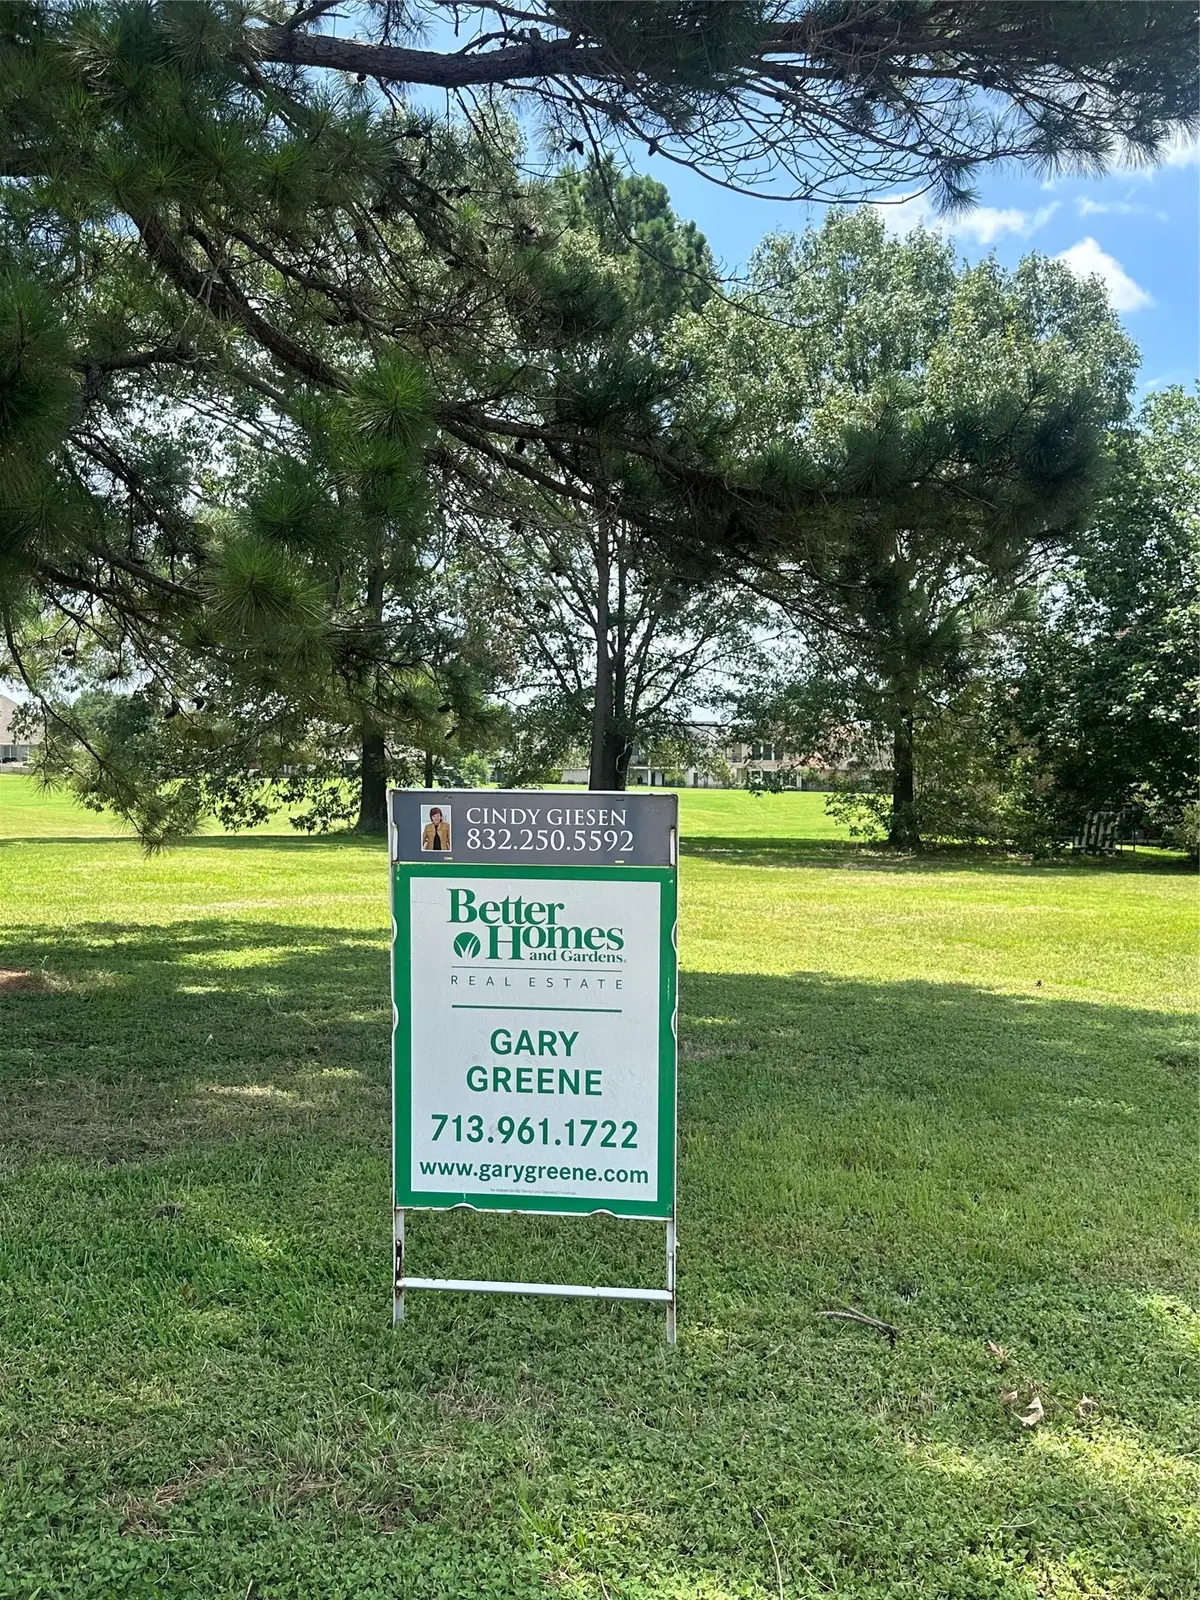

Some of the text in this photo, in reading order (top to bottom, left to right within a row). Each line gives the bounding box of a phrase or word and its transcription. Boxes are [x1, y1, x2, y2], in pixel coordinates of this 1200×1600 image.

[466, 807, 627, 826] CINDY GIESEN
[466, 828, 634, 852] 832.250.5592
[447, 888, 565, 925] Better
[486, 925, 625, 960] Homes
[529, 950, 556, 961] and
[451, 976, 623, 990] REAL ESTATE
[490, 1029, 579, 1056] GARY
[466, 1066, 602, 1095] GREENE
[431, 1114, 638, 1148] 713.961.1722
[420, 1161, 648, 1183] www.garygreene.com
